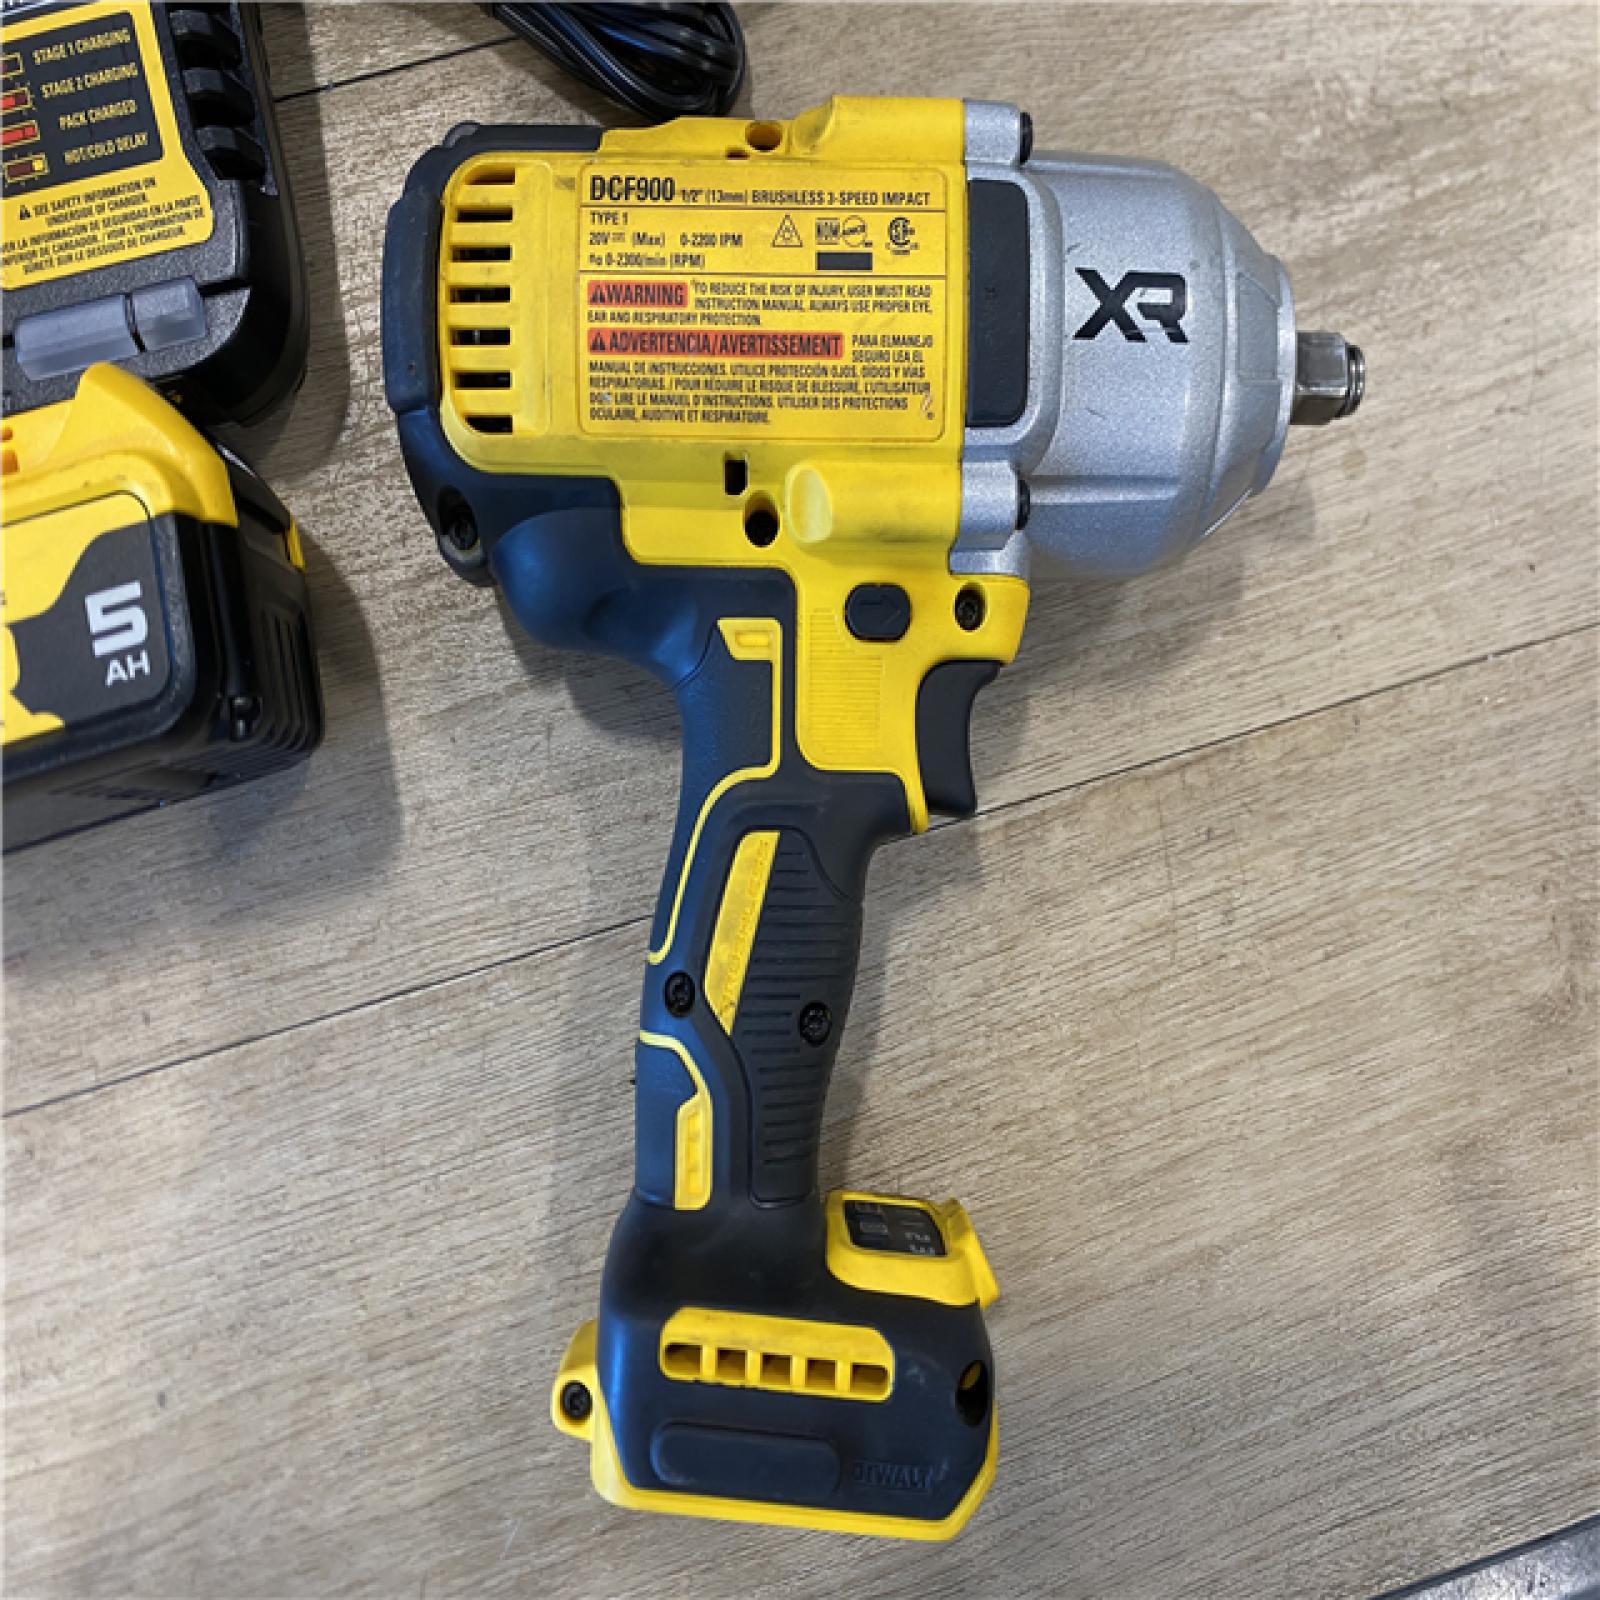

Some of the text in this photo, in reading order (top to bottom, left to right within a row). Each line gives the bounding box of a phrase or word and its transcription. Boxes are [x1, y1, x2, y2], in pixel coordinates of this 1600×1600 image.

[32, 28, 131, 65] STAGE 1 CHARGING
[40, 62, 138, 98] STAGE 2 CHARGING
[58, 99, 137, 130] PACK CHARGED
[115, 132, 148, 152] DELAY
[590, 175, 676, 202] DCF900
[705, 189, 748, 205] (13mm)
[752, 189, 825, 205] BRUSHLESS
[827, 190, 878, 206] 3-SPEED
[882, 192, 930, 206] IMPACT
[590, 211, 628, 225] TYPE 1
[589, 232, 610, 245] 20V
[632, 232, 666, 247] (Max)
[720, 232, 743, 247] IPM
[670, 252, 705, 269] (RPM)
[605, 283, 685, 306] WARNING
[710, 282, 746, 296] REDUCE
[749, 283, 767, 296] THE
[769, 284, 791, 296] RISK
[794, 284, 806, 296] OF
[848, 285, 873, 298] USER
[875, 285, 903, 298] MUST
[905, 285, 931, 298] READ
[695, 297, 761, 310] INSTRUCTION
[809, 299, 849, 313] ALWAYS
[850, 300, 871, 313] USE
[873, 300, 911, 313] PROPER
[1072, 267, 1188, 343] XR
[588, 310, 607, 323] EAR
[610, 312, 631, 324] AND
[632, 312, 698, 325] RESPIRATORY
[609, 331, 841, 356] ADVERTENCIA/AVERTISSEMENT
[852, 334, 878, 347] PARA
[852, 349, 923, 363] SEGURO LEA EL
[589, 360, 631, 373] MANUAL
[634, 362, 646, 374] DE
[730, 364, 766, 376] UTILICE
[893, 366, 900, 378] Y
[674, 378, 700, 390] POUR
[747, 379, 756, 392] LE
[760, 379, 793, 392] RISQUE
[796, 380, 808, 393] DE
[615, 392, 633, 405] LIRE
[637, 393, 646, 406] LE
[777, 396, 818, 409] UTILISER
[822, 397, 841, 410] DES
[843, 397, 908, 410] PROTECTIONS
[642, 409, 685, 422] AUDITIVE
[687, 410, 698, 422] ET
[85, 580, 148, 657] 5
[105, 651, 151, 687] AH
